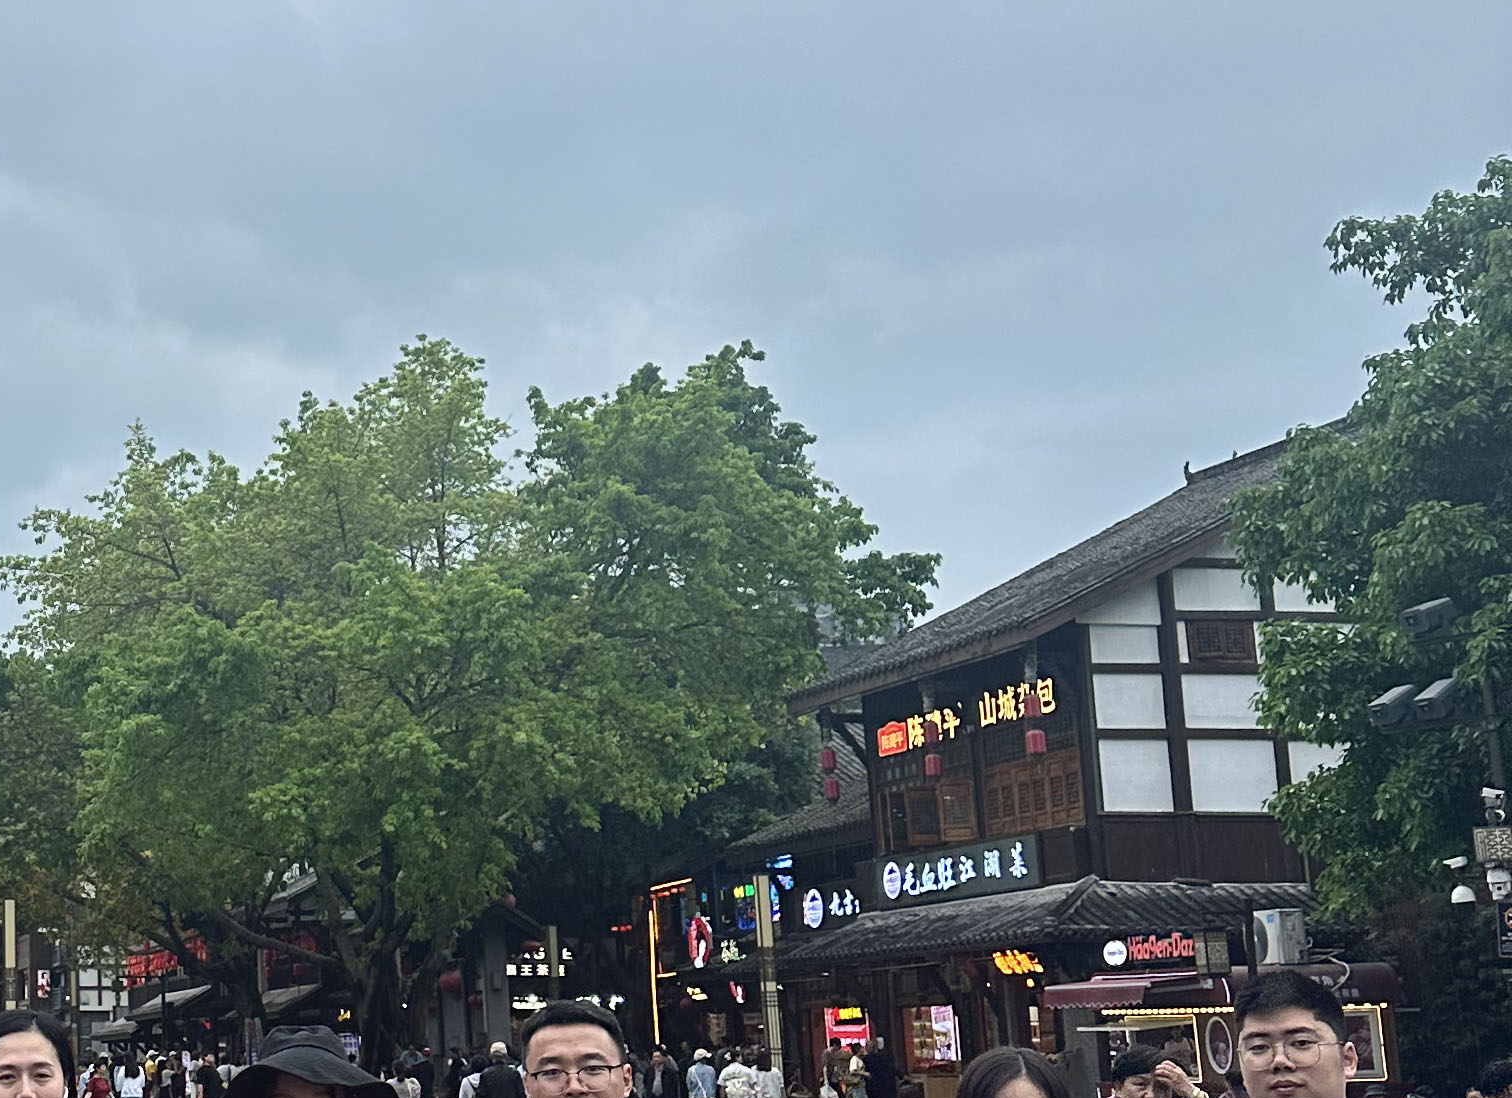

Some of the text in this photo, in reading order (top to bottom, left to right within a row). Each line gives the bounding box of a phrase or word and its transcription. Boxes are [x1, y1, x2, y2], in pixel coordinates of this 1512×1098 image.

[902, 841, 1029, 896] 毛血旺江湖菜
[1127, 933, 1194, 967] Häagen-Daz
